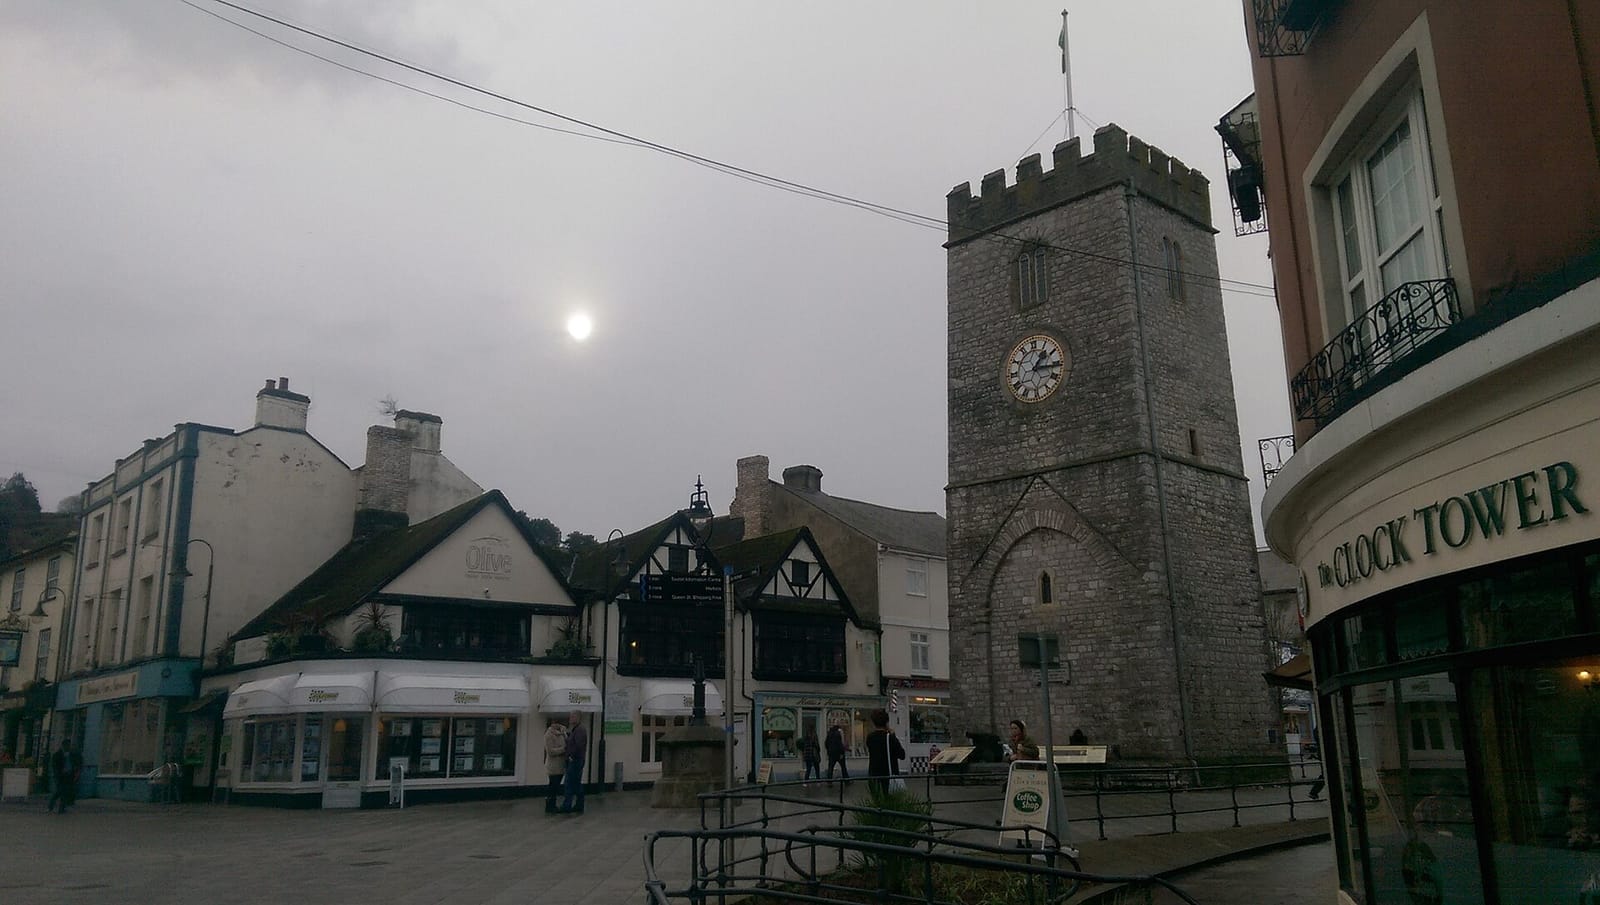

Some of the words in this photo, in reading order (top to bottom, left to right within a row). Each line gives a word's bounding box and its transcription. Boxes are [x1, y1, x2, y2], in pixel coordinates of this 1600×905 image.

[1333, 515, 1411, 588] CLOCK
[1413, 460, 1589, 556] TOWER
[465, 545, 513, 574] Olive
[1016, 793, 1038, 804] Coffee
[1021, 801, 1040, 812] Shop
